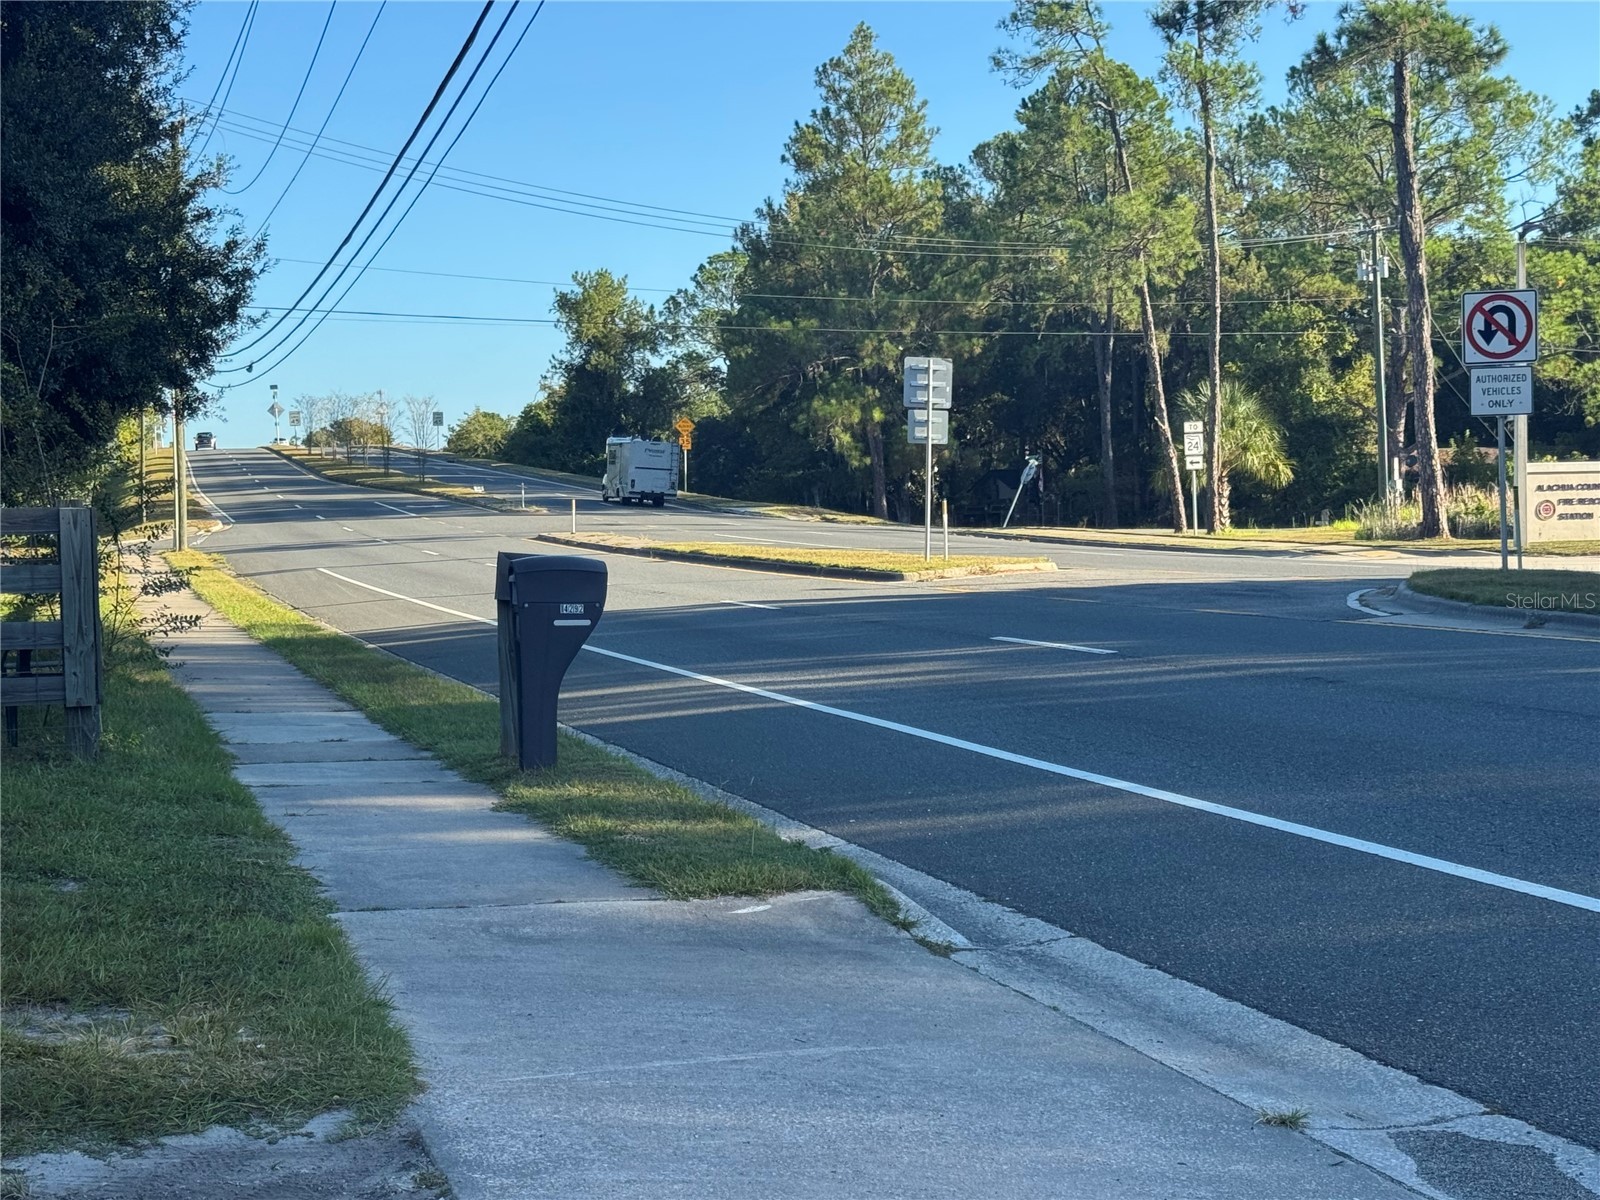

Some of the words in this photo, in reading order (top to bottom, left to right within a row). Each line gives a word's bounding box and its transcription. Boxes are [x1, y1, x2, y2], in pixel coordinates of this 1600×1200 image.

[1475, 374, 1527, 384] AUTHORIZED
[1481, 386, 1522, 396] VEHICLES
[1487, 399, 1515, 408] ONLY
[1188, 423, 1198, 431] TO
[1187, 441, 1199, 451] 24
[1534, 483, 1575, 493] ALACHUA
[1557, 498, 1577, 507] FIRE
[1557, 512, 1594, 521] STATION
